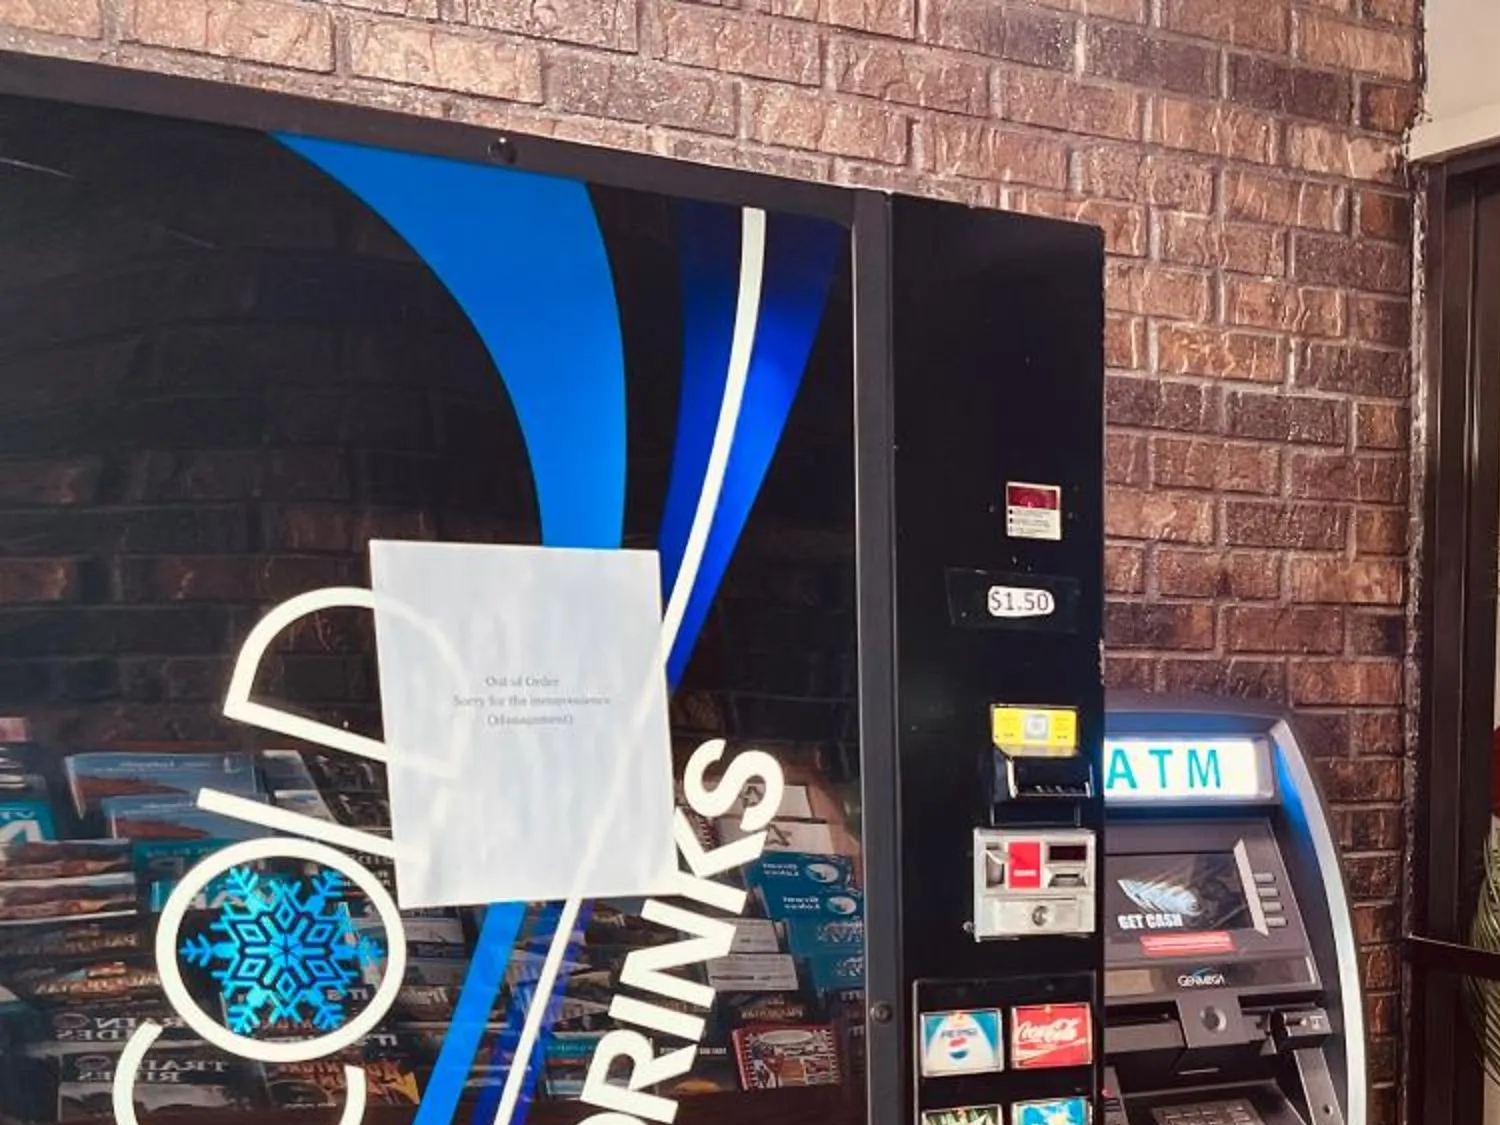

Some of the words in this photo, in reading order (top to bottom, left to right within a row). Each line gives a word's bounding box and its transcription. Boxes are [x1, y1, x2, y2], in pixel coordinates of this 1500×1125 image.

[990, 591, 1050, 612] $1.50
[485, 675, 507, 687] Out
[510, 675, 522, 687] of
[525, 675, 560, 687] Order
[453, 695, 485, 708] Sorry
[489, 694, 506, 705] for
[508, 694, 527, 705] the
[1105, 749, 1222, 790] ATM
[1117, 913, 1144, 929] GET
[1146, 912, 1184, 929] CASH
